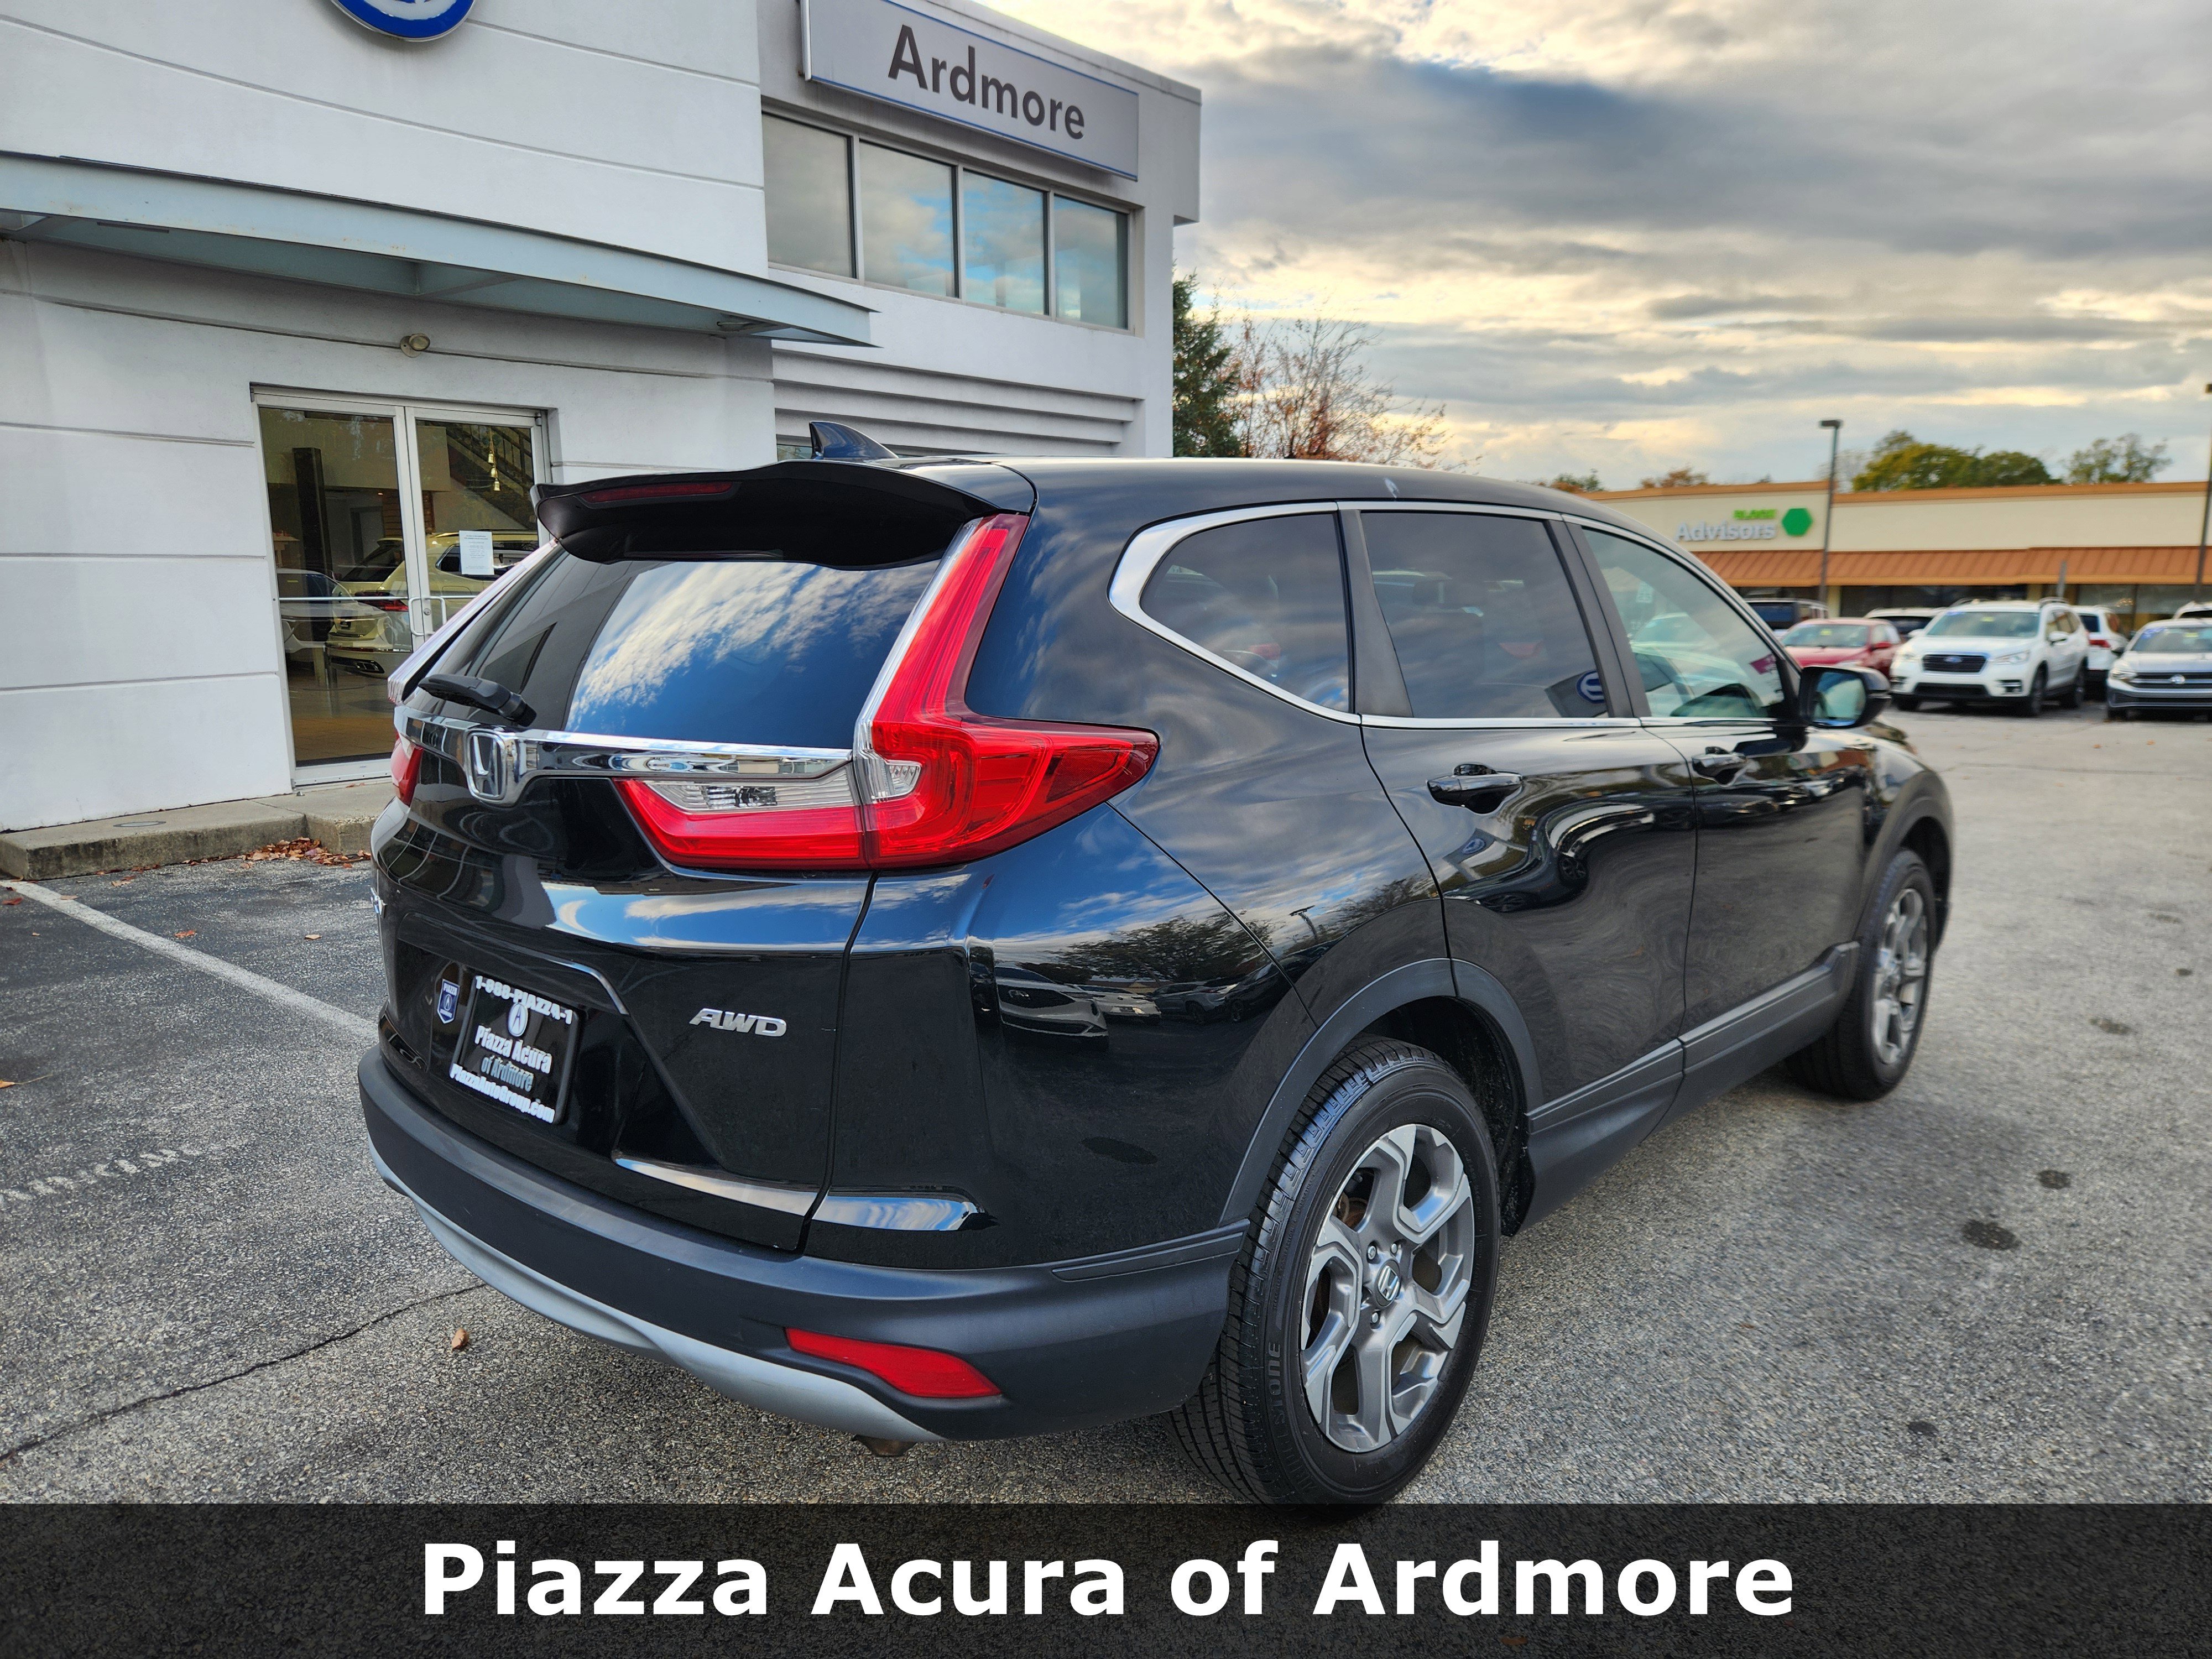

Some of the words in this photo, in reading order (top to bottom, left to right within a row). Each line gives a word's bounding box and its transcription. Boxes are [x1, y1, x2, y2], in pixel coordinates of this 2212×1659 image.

[888, 24, 1084, 139] Ardmore
[1674, 520, 1777, 541] Advisors
[689, 1008, 787, 1037] AWD
[474, 1025, 513, 1057] Piazza
[512, 1040, 552, 1073] Acura
[481, 1055, 494, 1074] of
[490, 1057, 535, 1092] Ardmore
